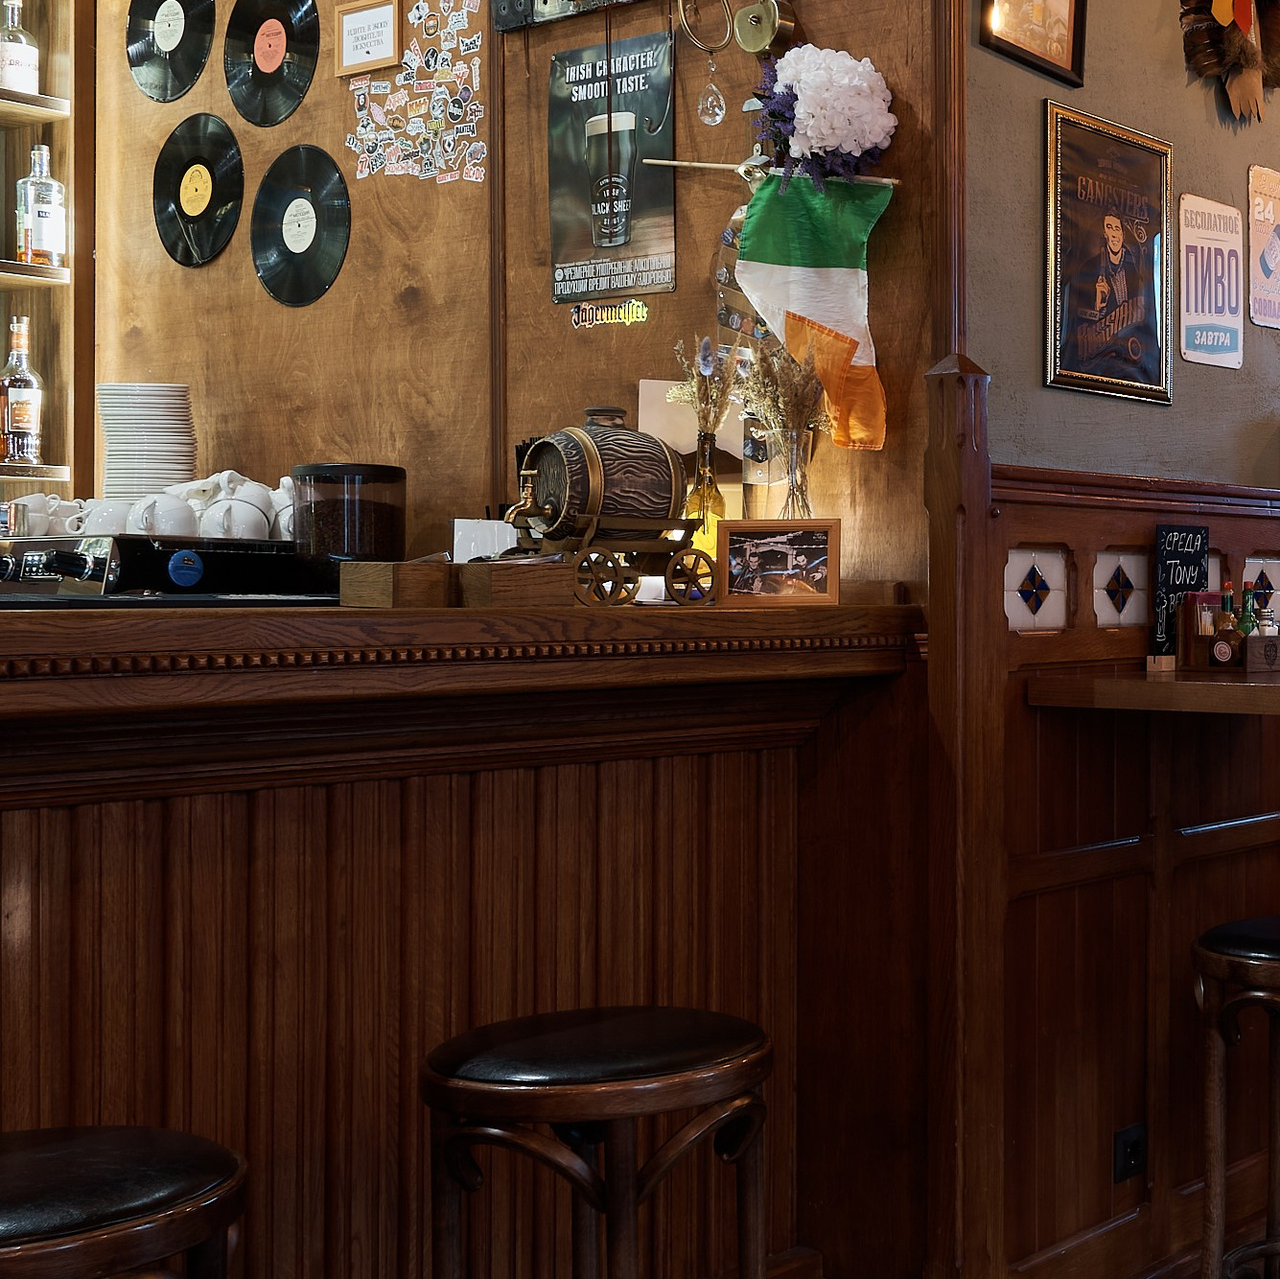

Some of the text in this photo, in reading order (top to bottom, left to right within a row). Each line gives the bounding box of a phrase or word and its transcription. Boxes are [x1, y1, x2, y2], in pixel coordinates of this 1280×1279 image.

[565, 50, 657, 83] IRISH CHARACTER.
[571, 74, 649, 102] SMOOT TASTE.
[1077, 176, 1149, 219] GANGSTERS
[1254, 196, 1275, 225] 24
[1184, 208, 1240, 235] БЕСПЛАТНОЕ
[554, 269, 672, 295] ПРОДУКЦИИ ВРЕДИТ ВАШЕМУ ЗДОРОВЬЮ
[564, 265, 597, 281] ЧРЕЗМЕРНОЕ
[596, 261, 634, 277] УПОТРЕБЛЕНИЕ
[1185, 244, 1240, 317] ПИВО
[1194, 330, 1231, 347] ЗАВТРА
[1165, 531, 1202, 554] СРЕДА
